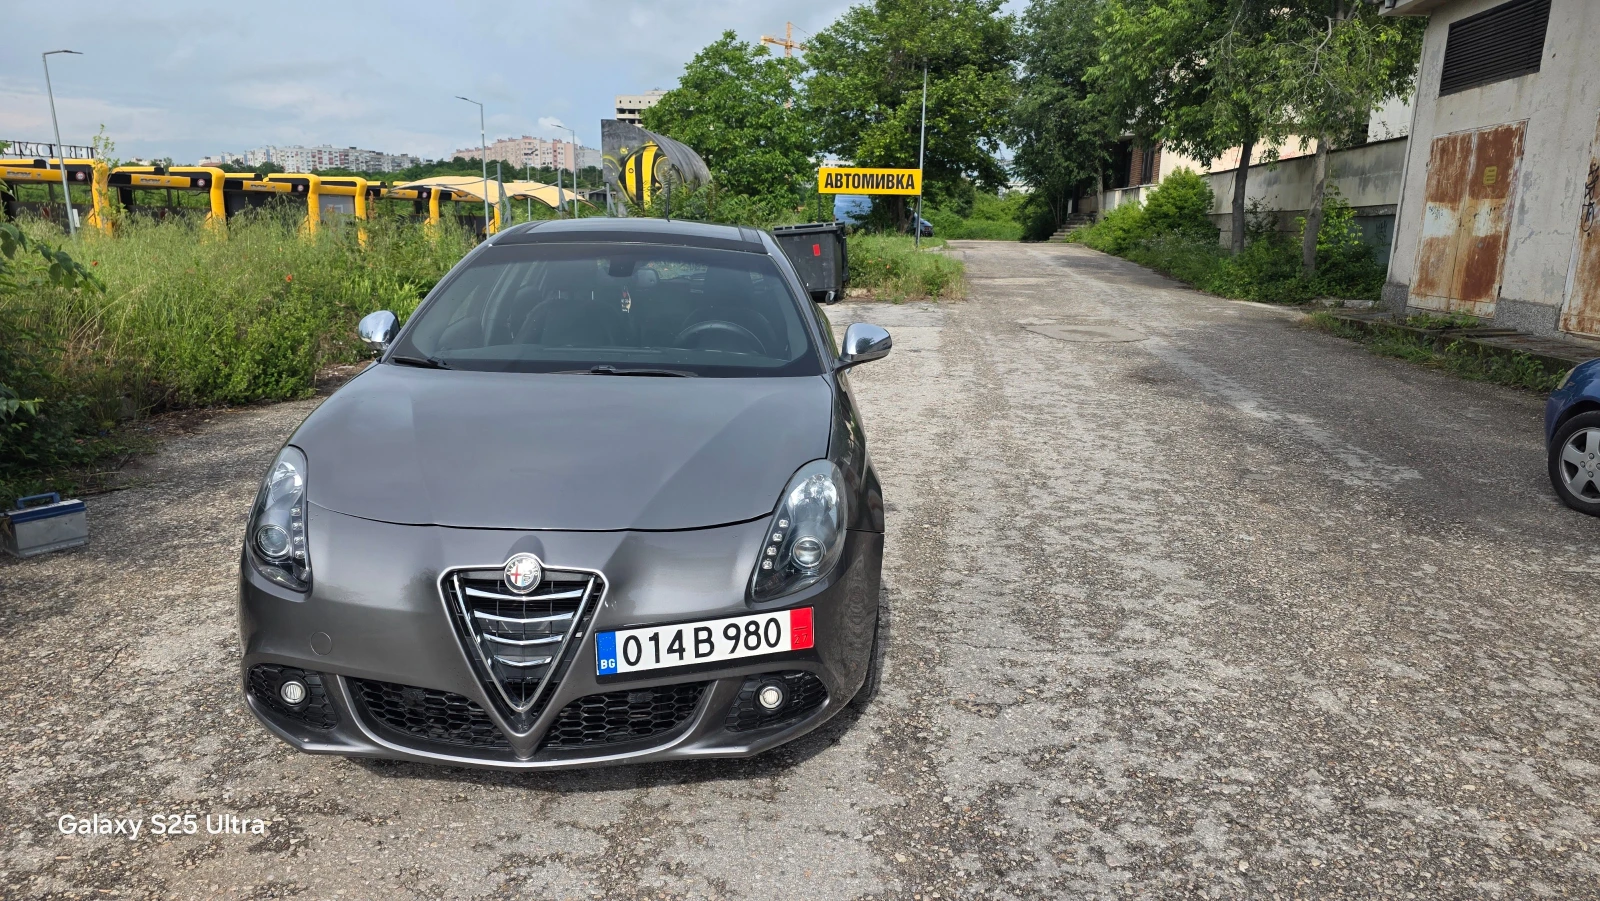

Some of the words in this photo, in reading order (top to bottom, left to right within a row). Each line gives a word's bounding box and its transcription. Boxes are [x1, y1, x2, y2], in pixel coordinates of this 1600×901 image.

[824, 172, 915, 190] АВТОМИВКА
[622, 628, 686, 667] 014
[693, 626, 715, 659] B
[722, 617, 782, 655] 980
[600, 658, 616, 670] BG
